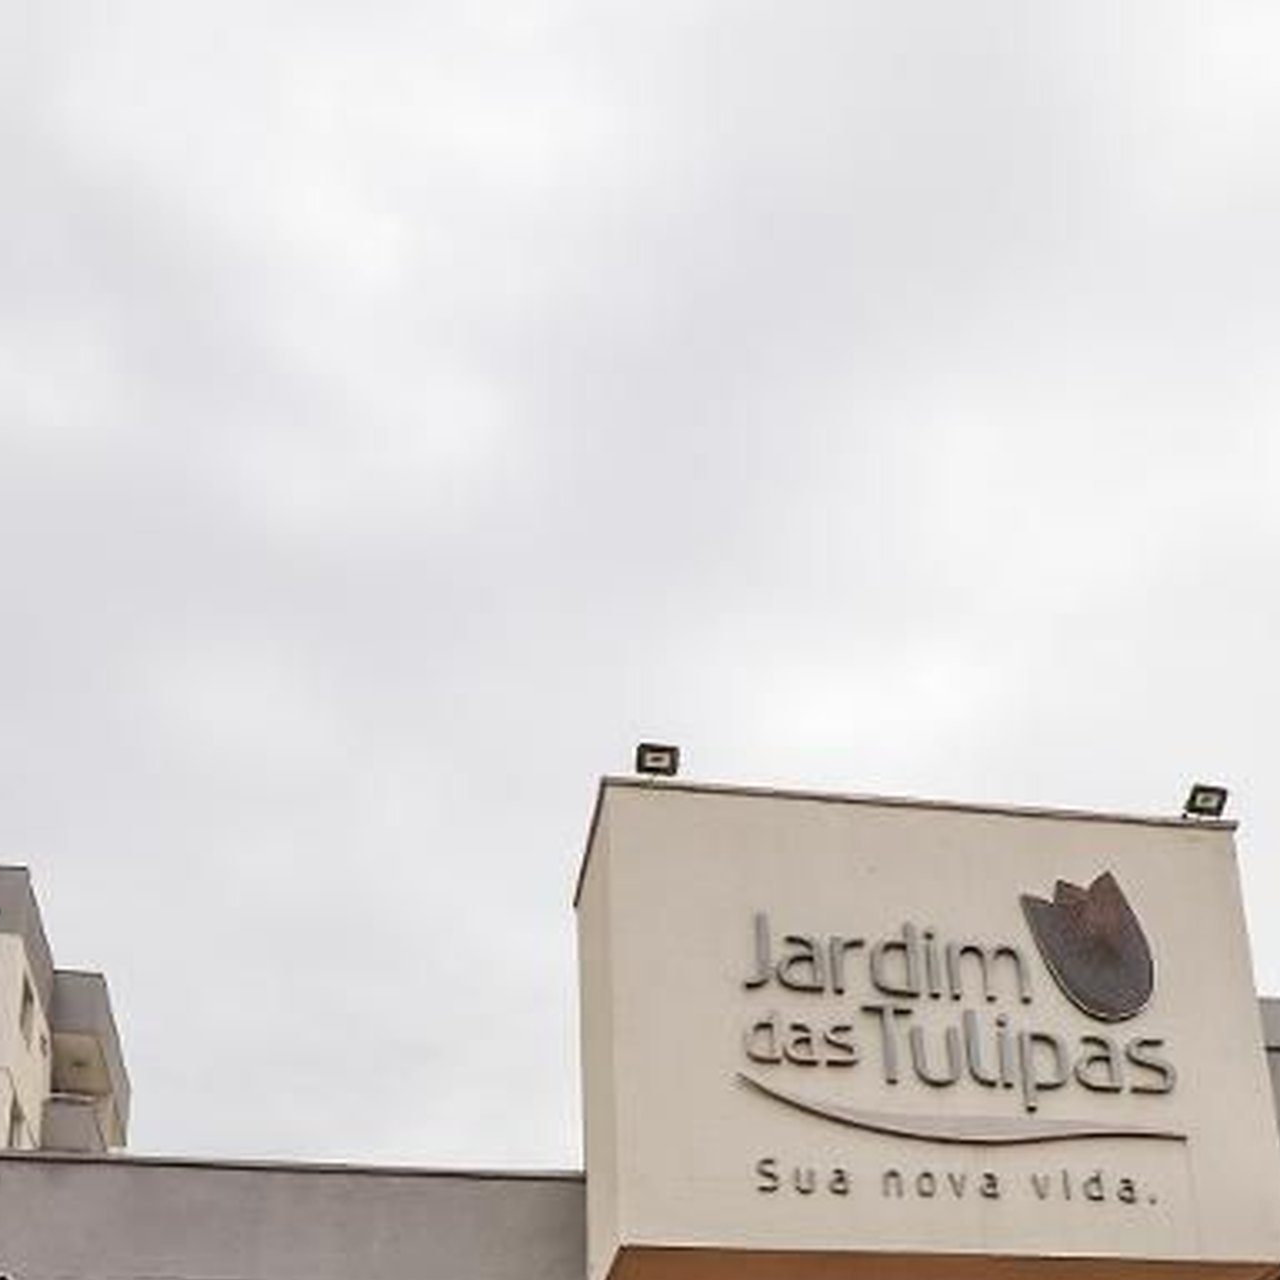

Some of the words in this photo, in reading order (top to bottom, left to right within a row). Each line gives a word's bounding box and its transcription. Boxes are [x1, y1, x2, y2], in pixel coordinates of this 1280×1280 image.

[743, 910, 1034, 1005] Jardim
[744, 1010, 858, 1068] das
[860, 1003, 1178, 1113] Tulipas
[755, 1157, 852, 1196] Sua
[881, 1168, 1001, 1200] nova
